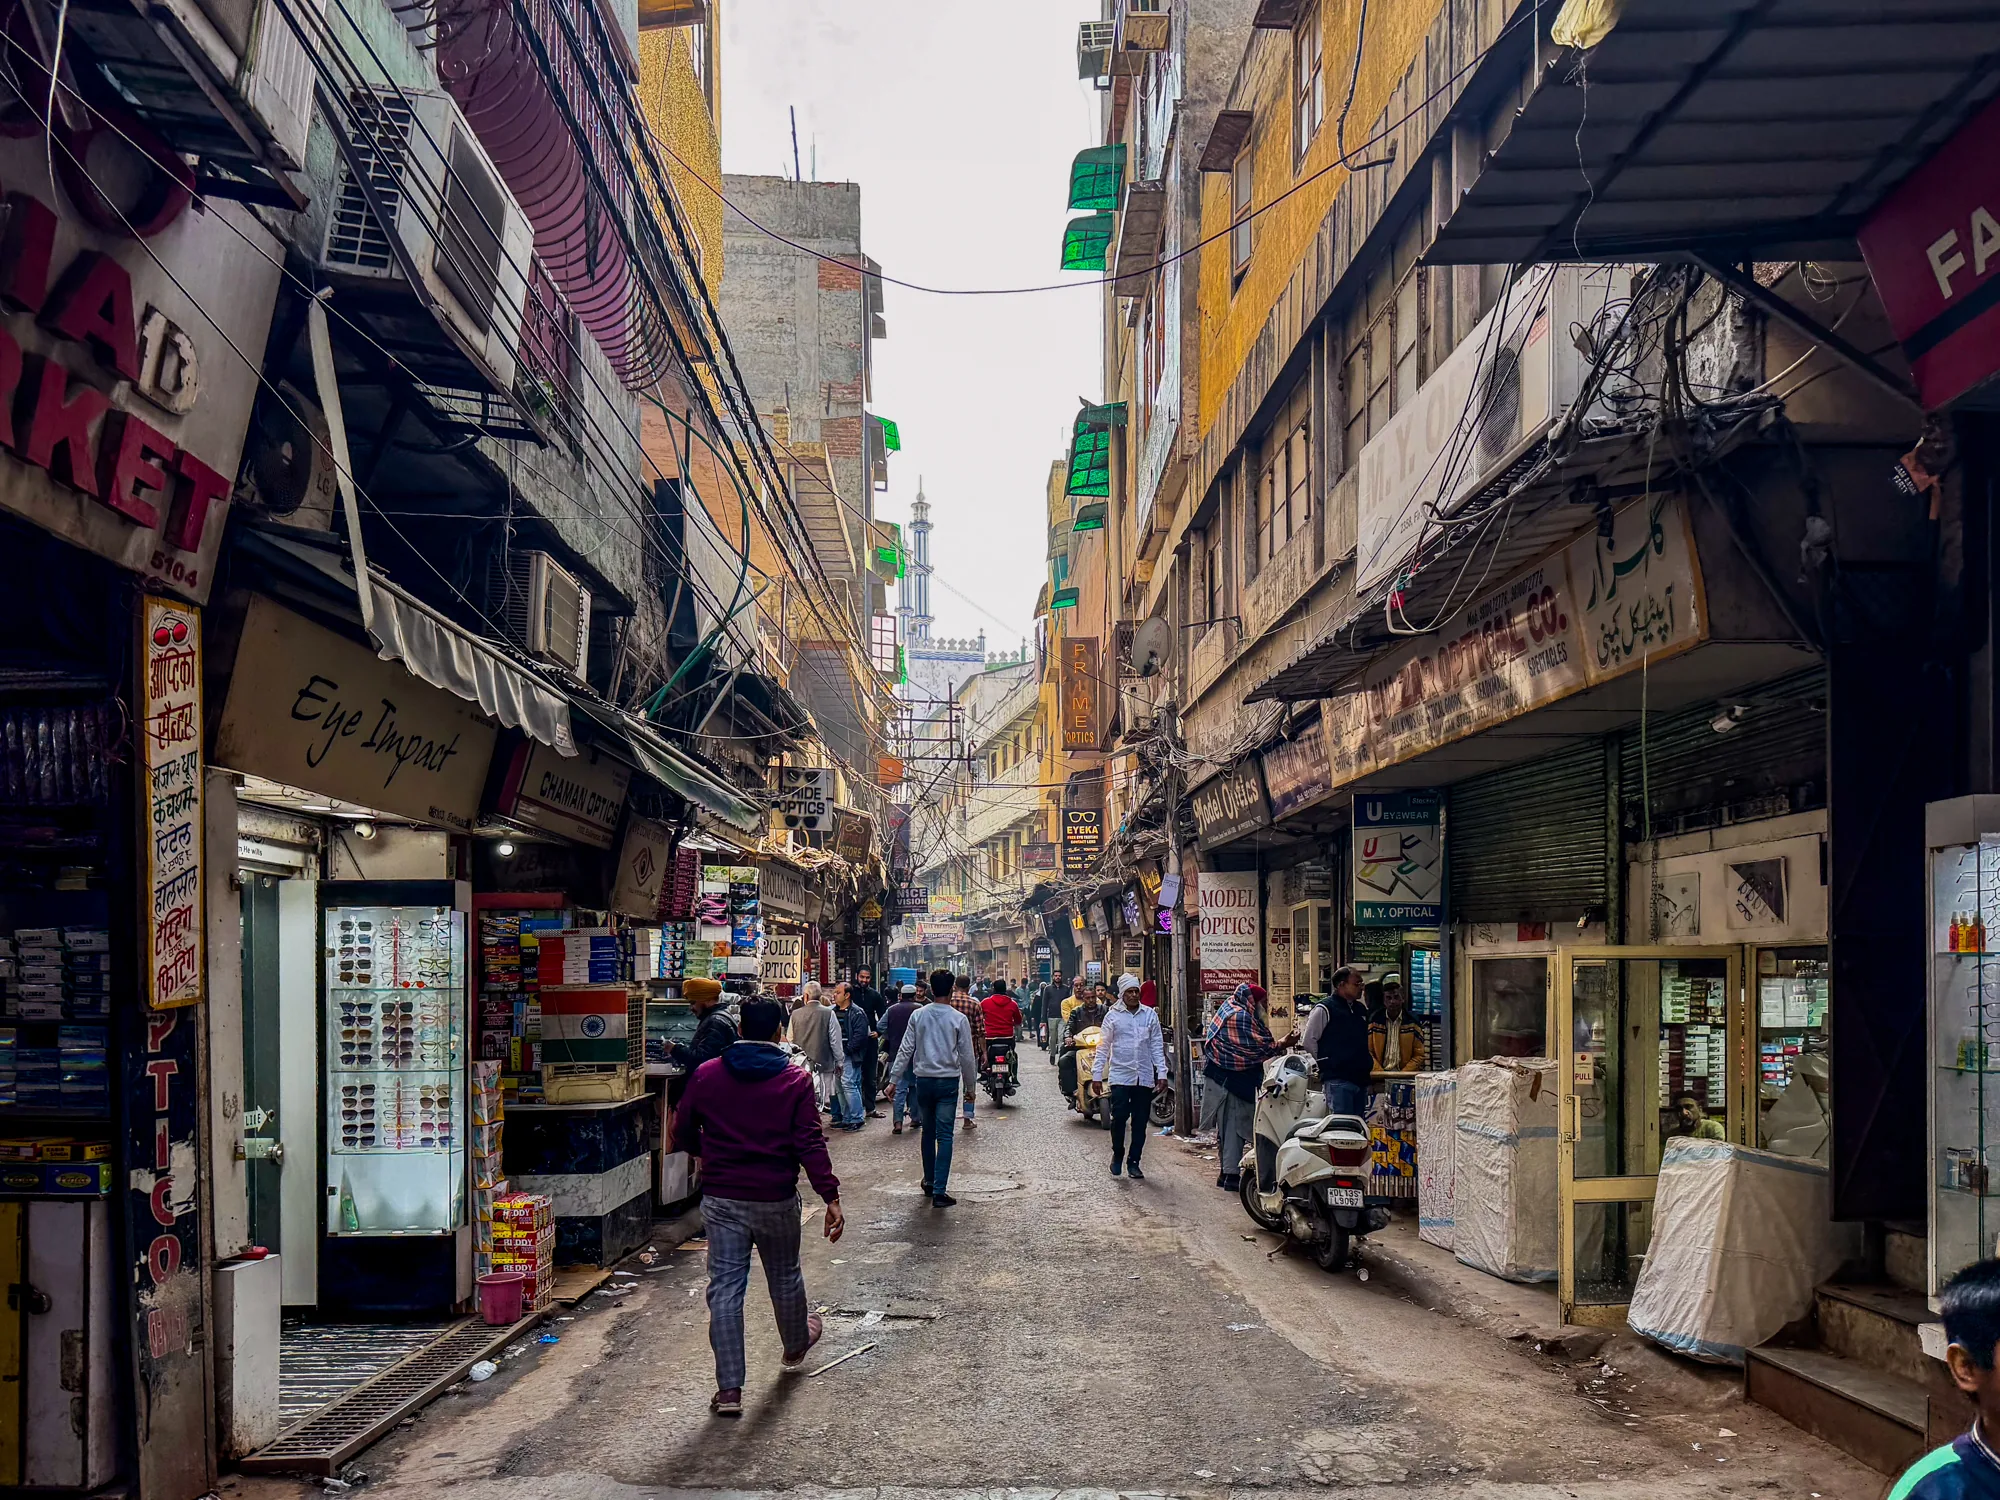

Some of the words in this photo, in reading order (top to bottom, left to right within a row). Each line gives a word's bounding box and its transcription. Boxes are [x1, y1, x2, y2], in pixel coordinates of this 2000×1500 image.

[317, 472, 330, 496] LG
[151, 550, 198, 588] 5104
[1438, 606, 1528, 694] OPTICAL
[1527, 585, 1568, 645] CO.
[1529, 642, 1568, 678] SPECTACLES
[1073, 643, 1088, 728] PRIME
[291, 674, 364, 768] Eye
[361, 698, 460, 788] Impact
[1066, 731, 1094, 744] OPTICS
[540, 771, 588, 813] CHAMAN
[586, 792, 620, 826] OPTICS
[783, 786, 822, 800] PRIDE
[778, 801, 825, 815] OPTICS
[1193, 785, 1224, 836] Model
[1222, 776, 1260, 815] Optics
[1366, 801, 1383, 822] U
[1383, 811, 1429, 820] EYEWEAR
[1067, 825, 1099, 834] EYEKA
[840, 846, 862, 858] STORE
[1363, 837, 1379, 858] U
[762, 867, 786, 900] APOLLO
[896, 888, 927, 898] NICE
[1201, 889, 1256, 908] MODEL
[1363, 908, 1375, 918] M.
[1377, 908, 1386, 918] Y.
[1389, 907, 1435, 918] OPTICAL
[1201, 917, 1255, 935] OPTICS
[760, 961, 797, 979] OPTICS
[60, 1176, 88, 1184] Perfect
[503, 1264, 533, 1272] REDDY
